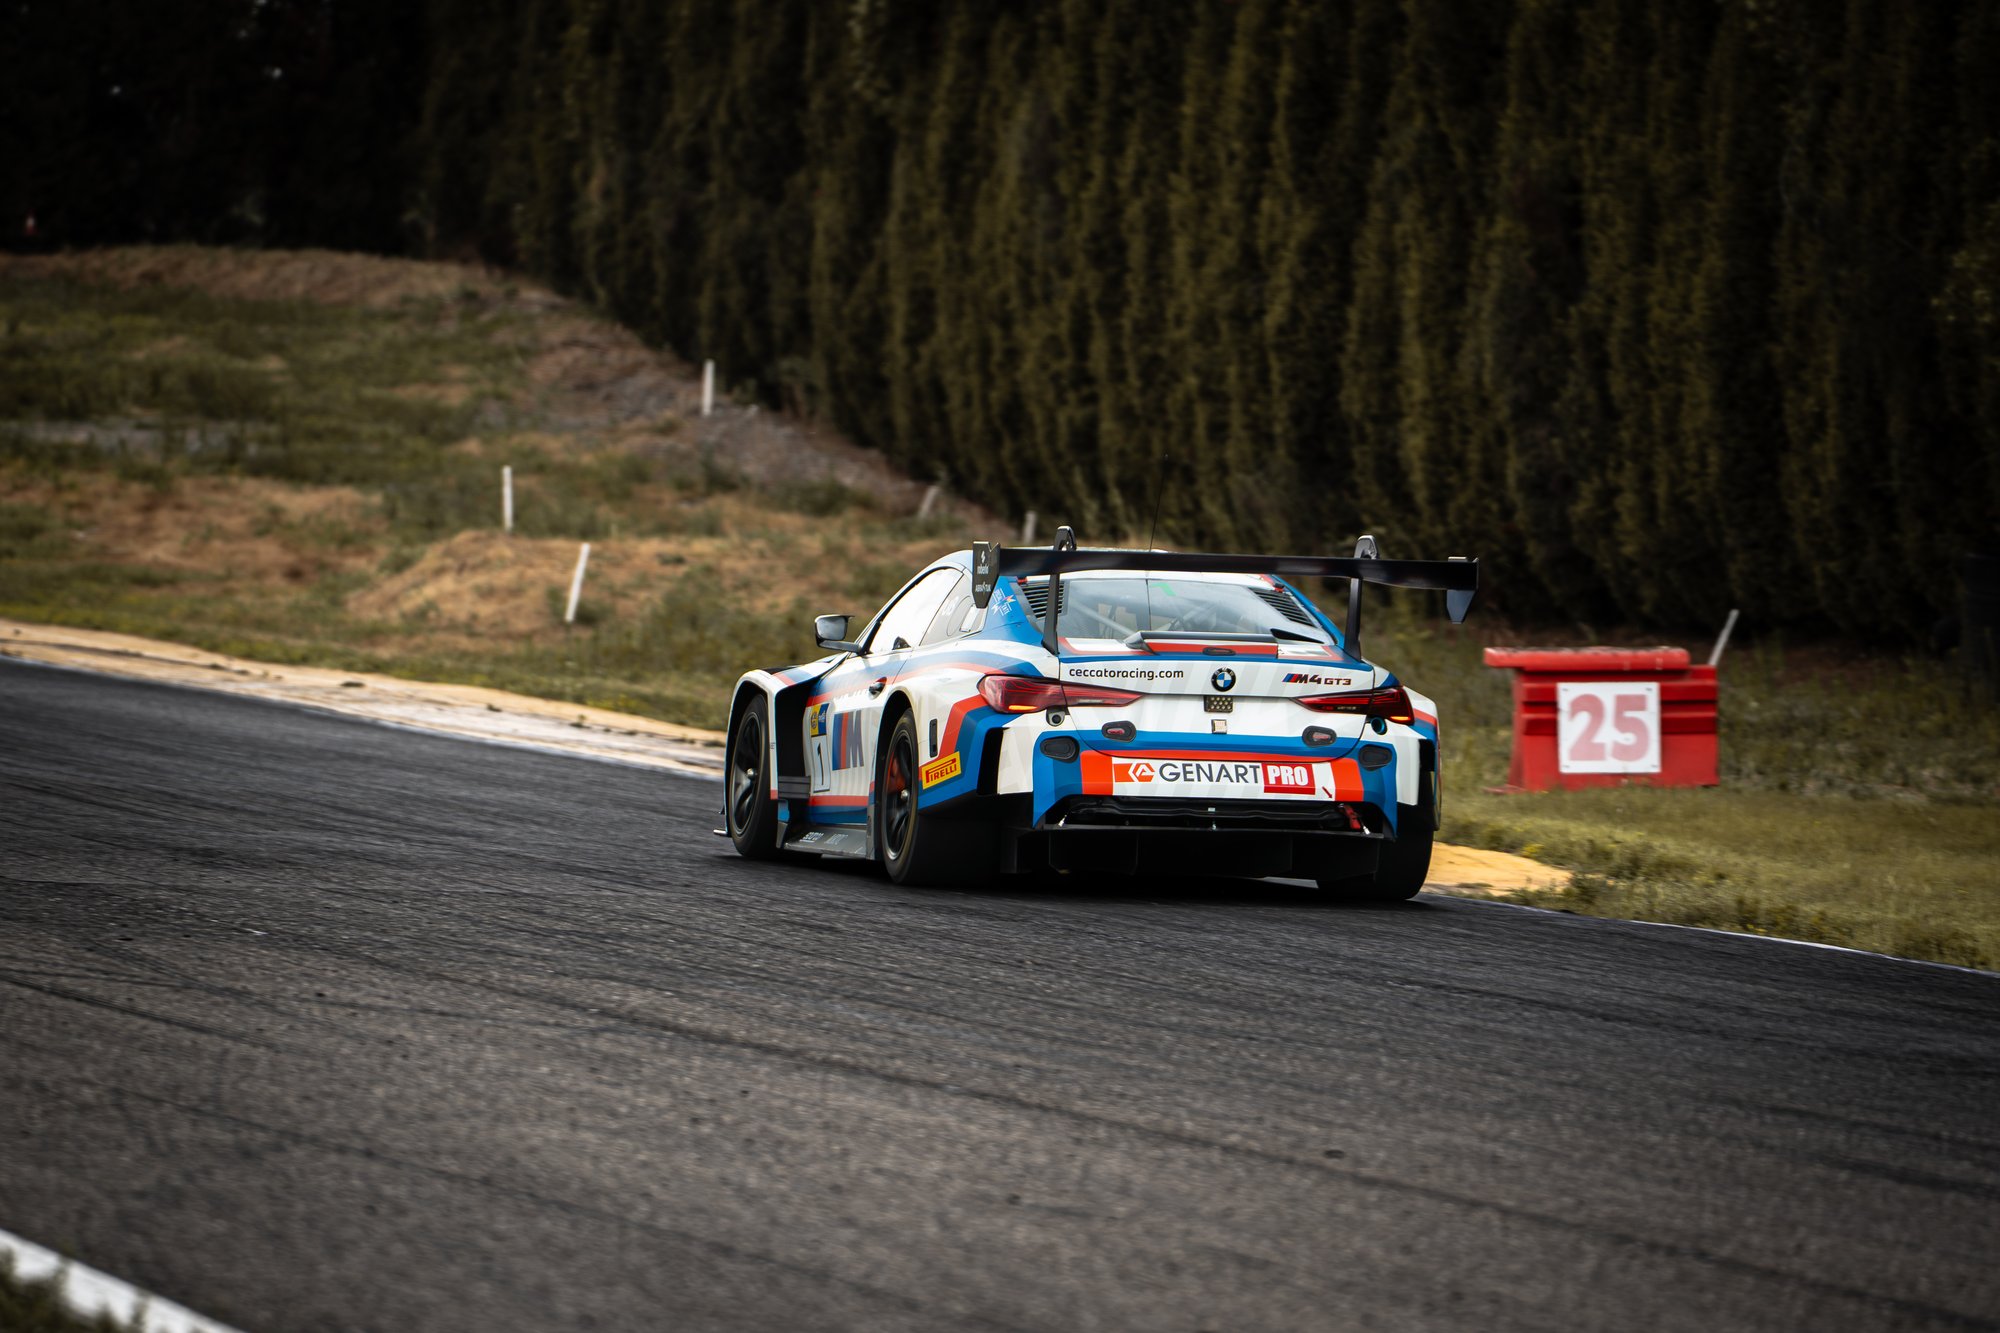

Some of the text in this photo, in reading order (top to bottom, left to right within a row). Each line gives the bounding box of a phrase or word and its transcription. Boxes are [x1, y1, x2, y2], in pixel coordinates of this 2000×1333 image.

[1068, 666, 1184, 680] ceccatoracing.com
[1295, 673, 1352, 686] M4 GT3
[1568, 693, 1650, 762] 25
[925, 757, 957, 784] PIRELLI
[1159, 762, 1309, 786] GENART PRO
